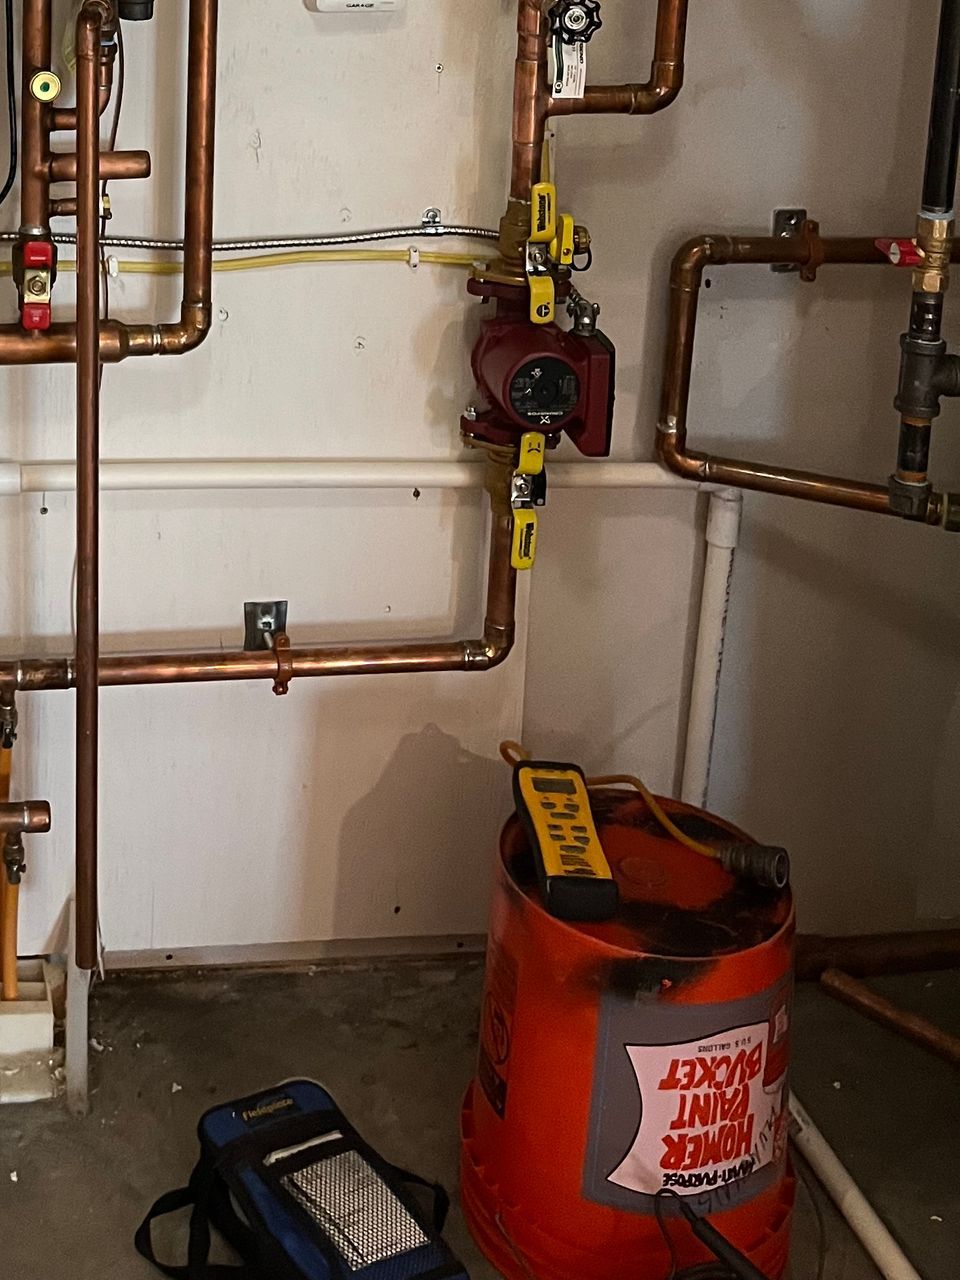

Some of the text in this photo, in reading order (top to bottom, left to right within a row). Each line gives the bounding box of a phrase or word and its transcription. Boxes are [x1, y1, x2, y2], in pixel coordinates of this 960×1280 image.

[657, 1040, 762, 1091] BUCKET
[697, 1043, 731, 1053] GALLONS
[670, 1084, 749, 1130] PAINT
[660, 1114, 754, 1170] HOMER
